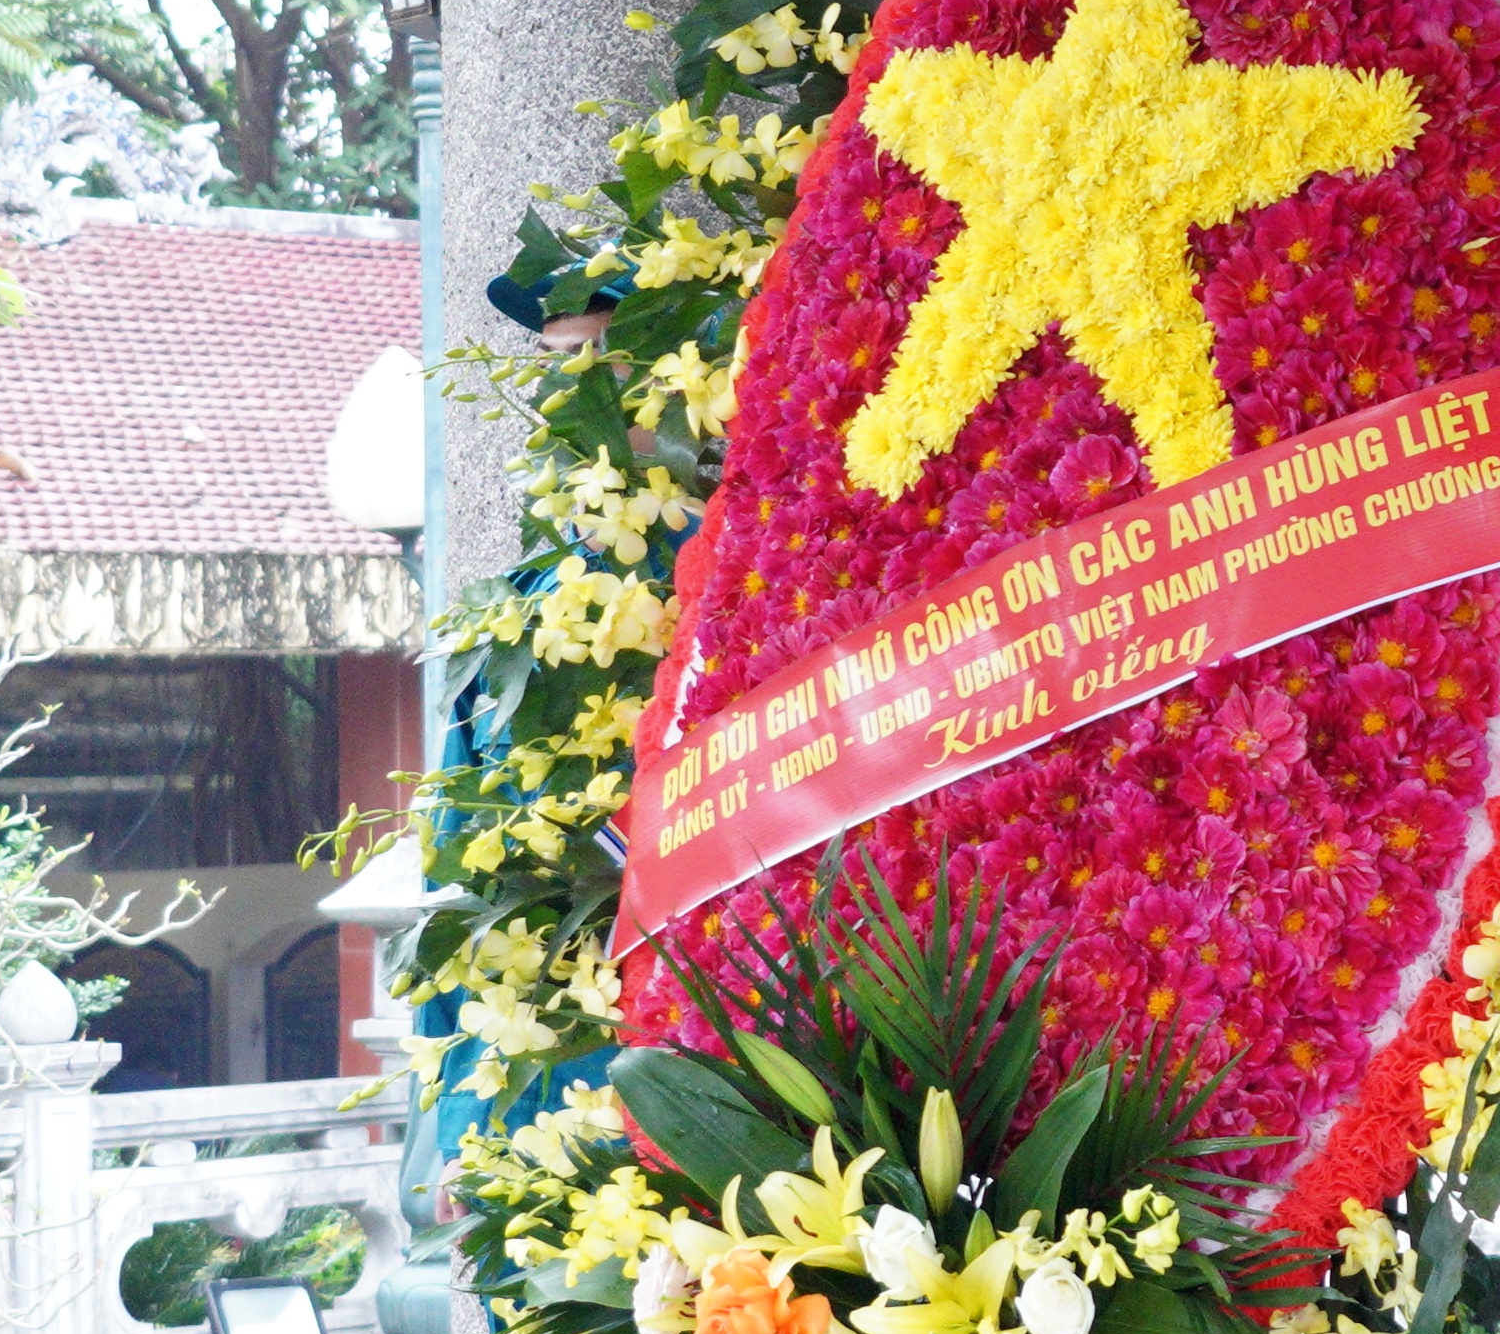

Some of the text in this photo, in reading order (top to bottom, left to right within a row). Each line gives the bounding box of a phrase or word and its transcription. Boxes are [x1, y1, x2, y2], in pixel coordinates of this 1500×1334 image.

[663, 743, 701, 810] ĐỜI
[707, 712, 758, 774] ĐỜI
[766, 677, 818, 740] GHI
[823, 630, 896, 708] NHỚ
[904, 585, 1000, 666] CÔNG
[1003, 554, 1061, 613] ƠN
[1069, 522, 1155, 586] CÁC
[1169, 476, 1257, 549] ANH
[1263, 427, 1389, 507] HÙNG
[1396, 392, 1490, 457] LIỆT
[720, 770, 749, 818] UỶ
[771, 733, 838, 792] HĐND
[860, 687, 931, 745] UBND
[954, 623, 1065, 699] UBMTTQ
[1069, 592, 1135, 648] VIỆT
[1142, 560, 1219, 617] NAM
[1224, 505, 1358, 583] PHƯỜNG
[924, 623, 1214, 769] Kính viếng
